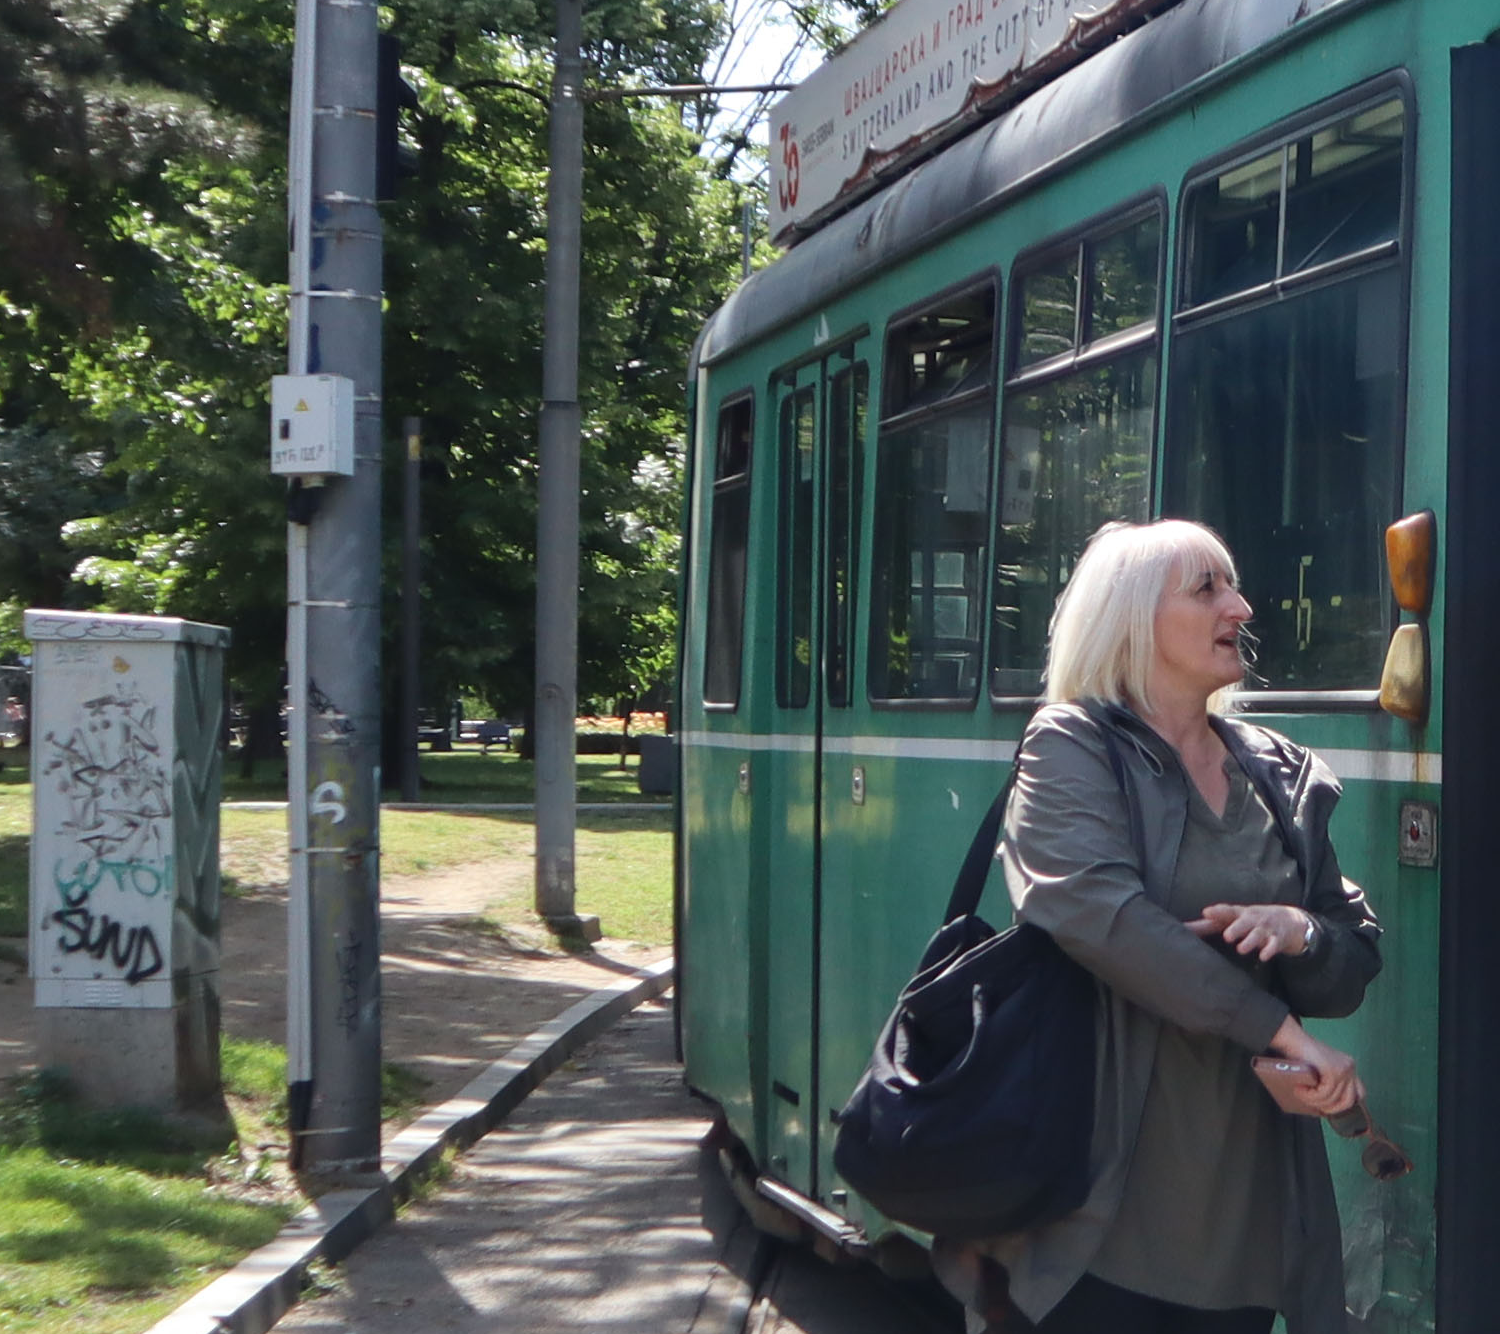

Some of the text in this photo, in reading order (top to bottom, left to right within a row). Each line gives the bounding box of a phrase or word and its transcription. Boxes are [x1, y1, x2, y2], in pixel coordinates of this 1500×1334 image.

[932, 19, 941, 51] И
[841, 81, 922, 161] SWITZERLAND
[927, 60, 954, 101] AND
[961, 34, 987, 79] THE
[994, 4, 1029, 55] CITY
